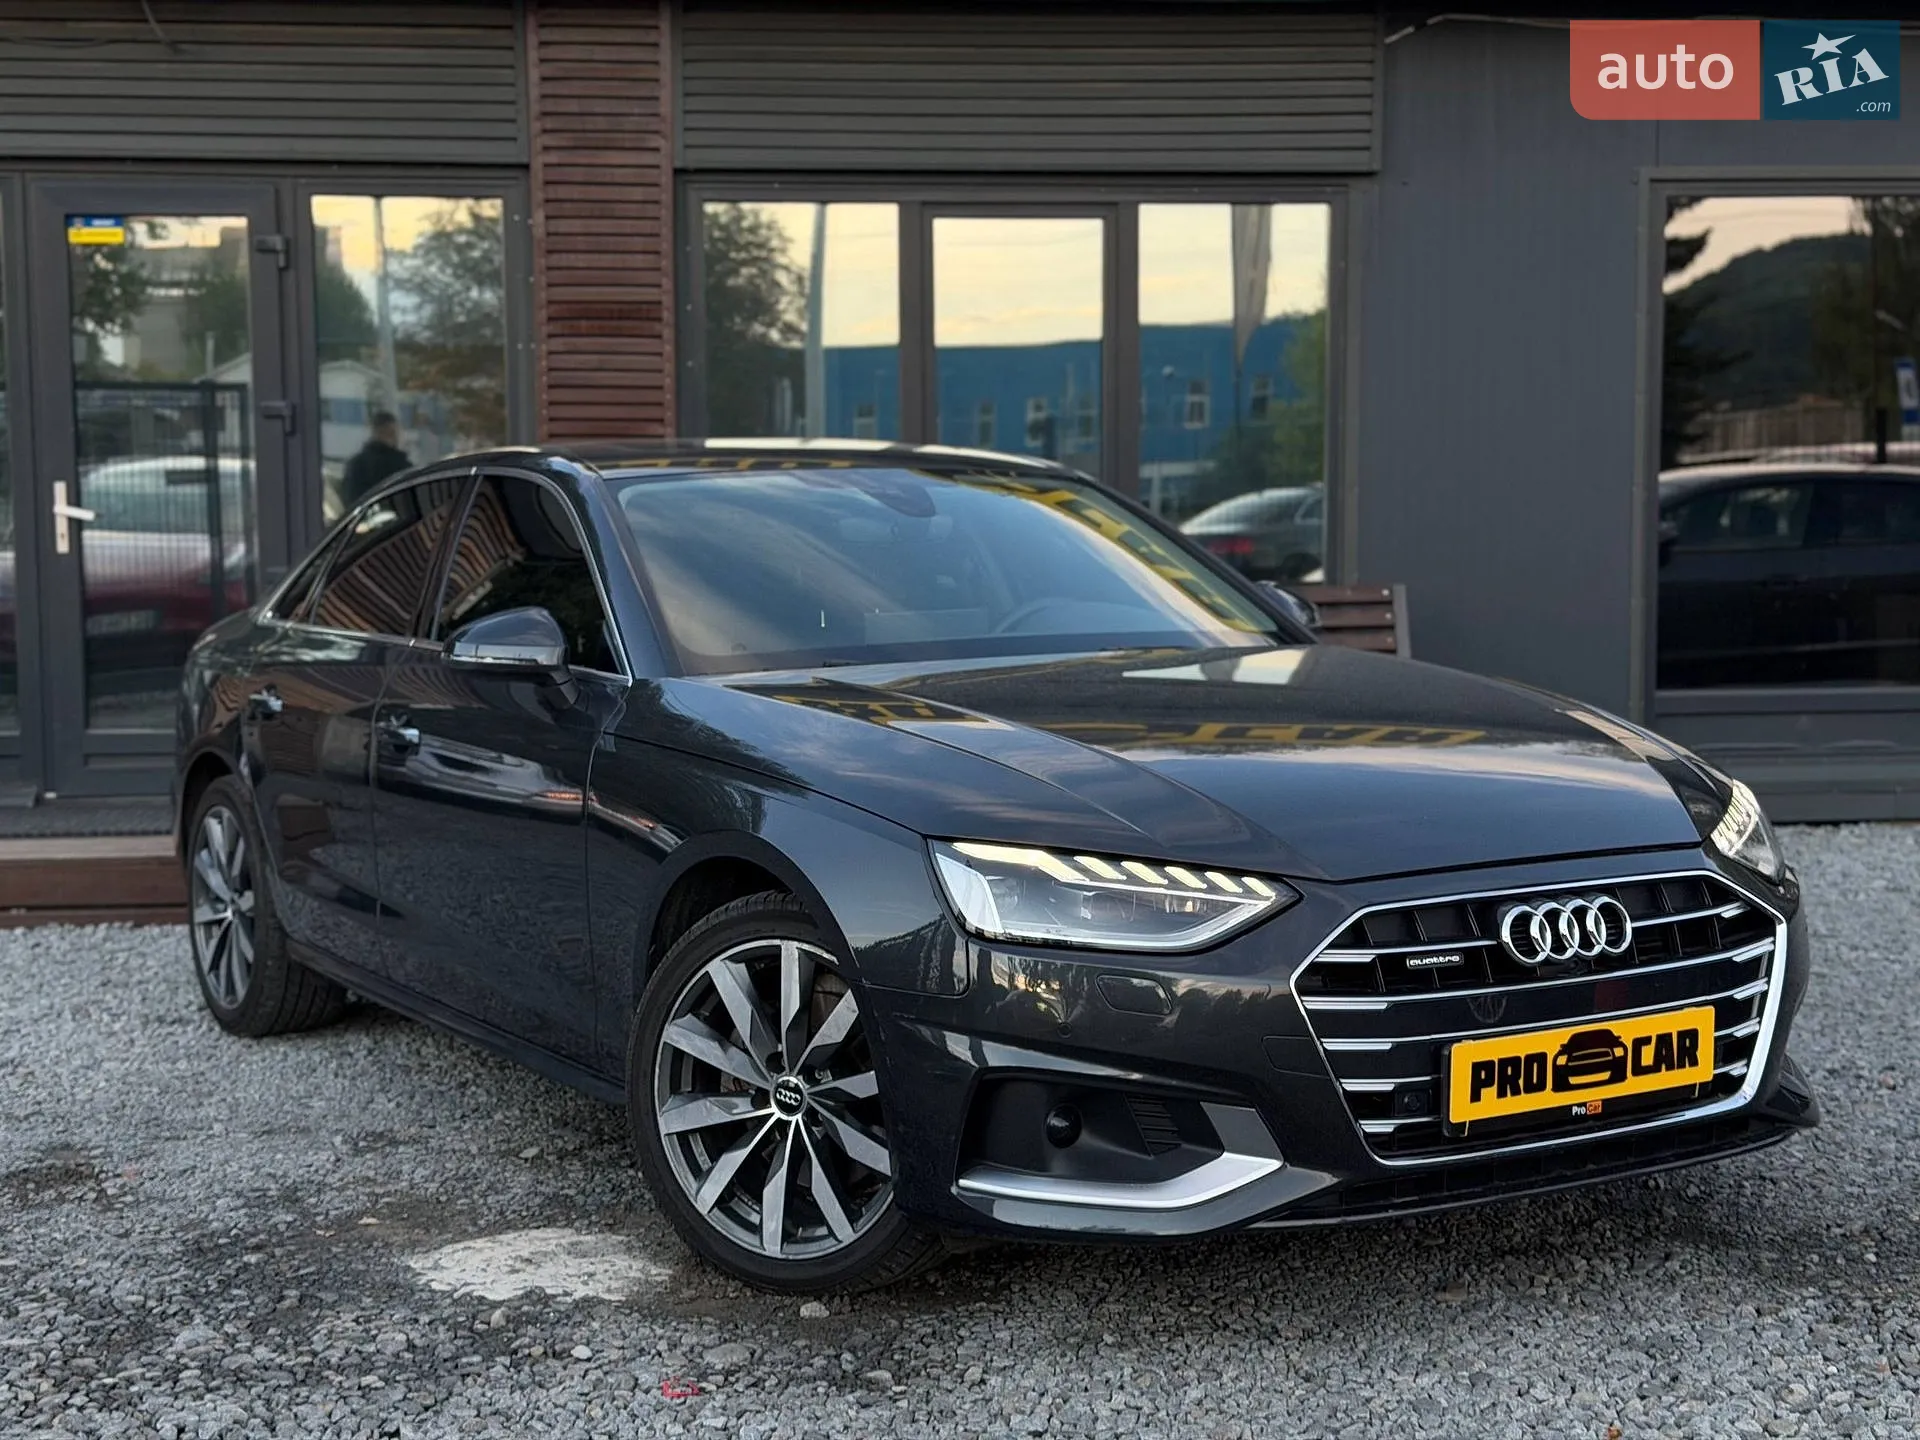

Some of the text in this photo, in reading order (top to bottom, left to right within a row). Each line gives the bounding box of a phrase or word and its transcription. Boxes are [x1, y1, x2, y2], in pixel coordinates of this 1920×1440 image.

[1409, 955, 1460, 966] quattro
[1470, 1028, 1699, 1104] PRO CAR
